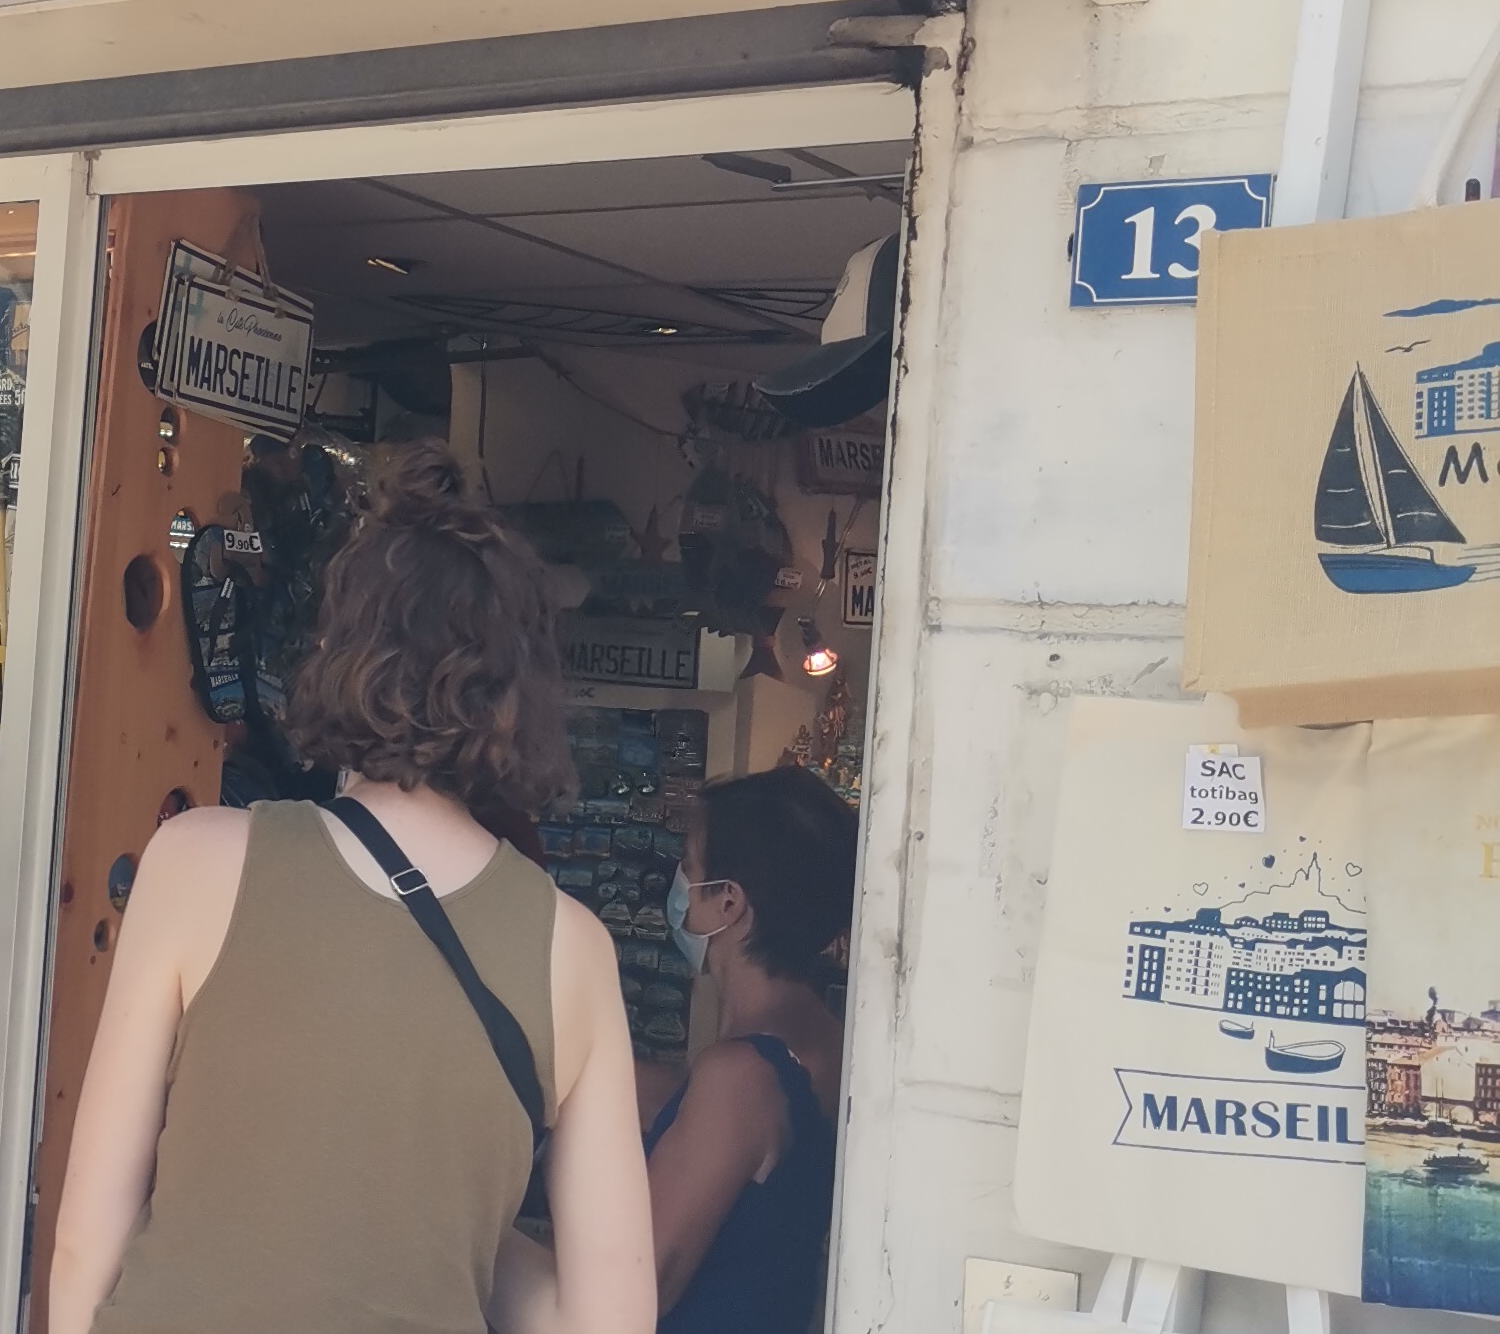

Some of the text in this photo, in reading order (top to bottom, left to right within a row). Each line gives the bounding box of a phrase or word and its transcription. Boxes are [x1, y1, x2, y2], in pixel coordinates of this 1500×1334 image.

[1120, 204, 1218, 282] 13
[186, 335, 303, 415] MARSEILLE
[224, 531, 262, 553] 9.90€
[1200, 759, 1247, 782] SAC
[1190, 807, 1260, 829] 2.90€
